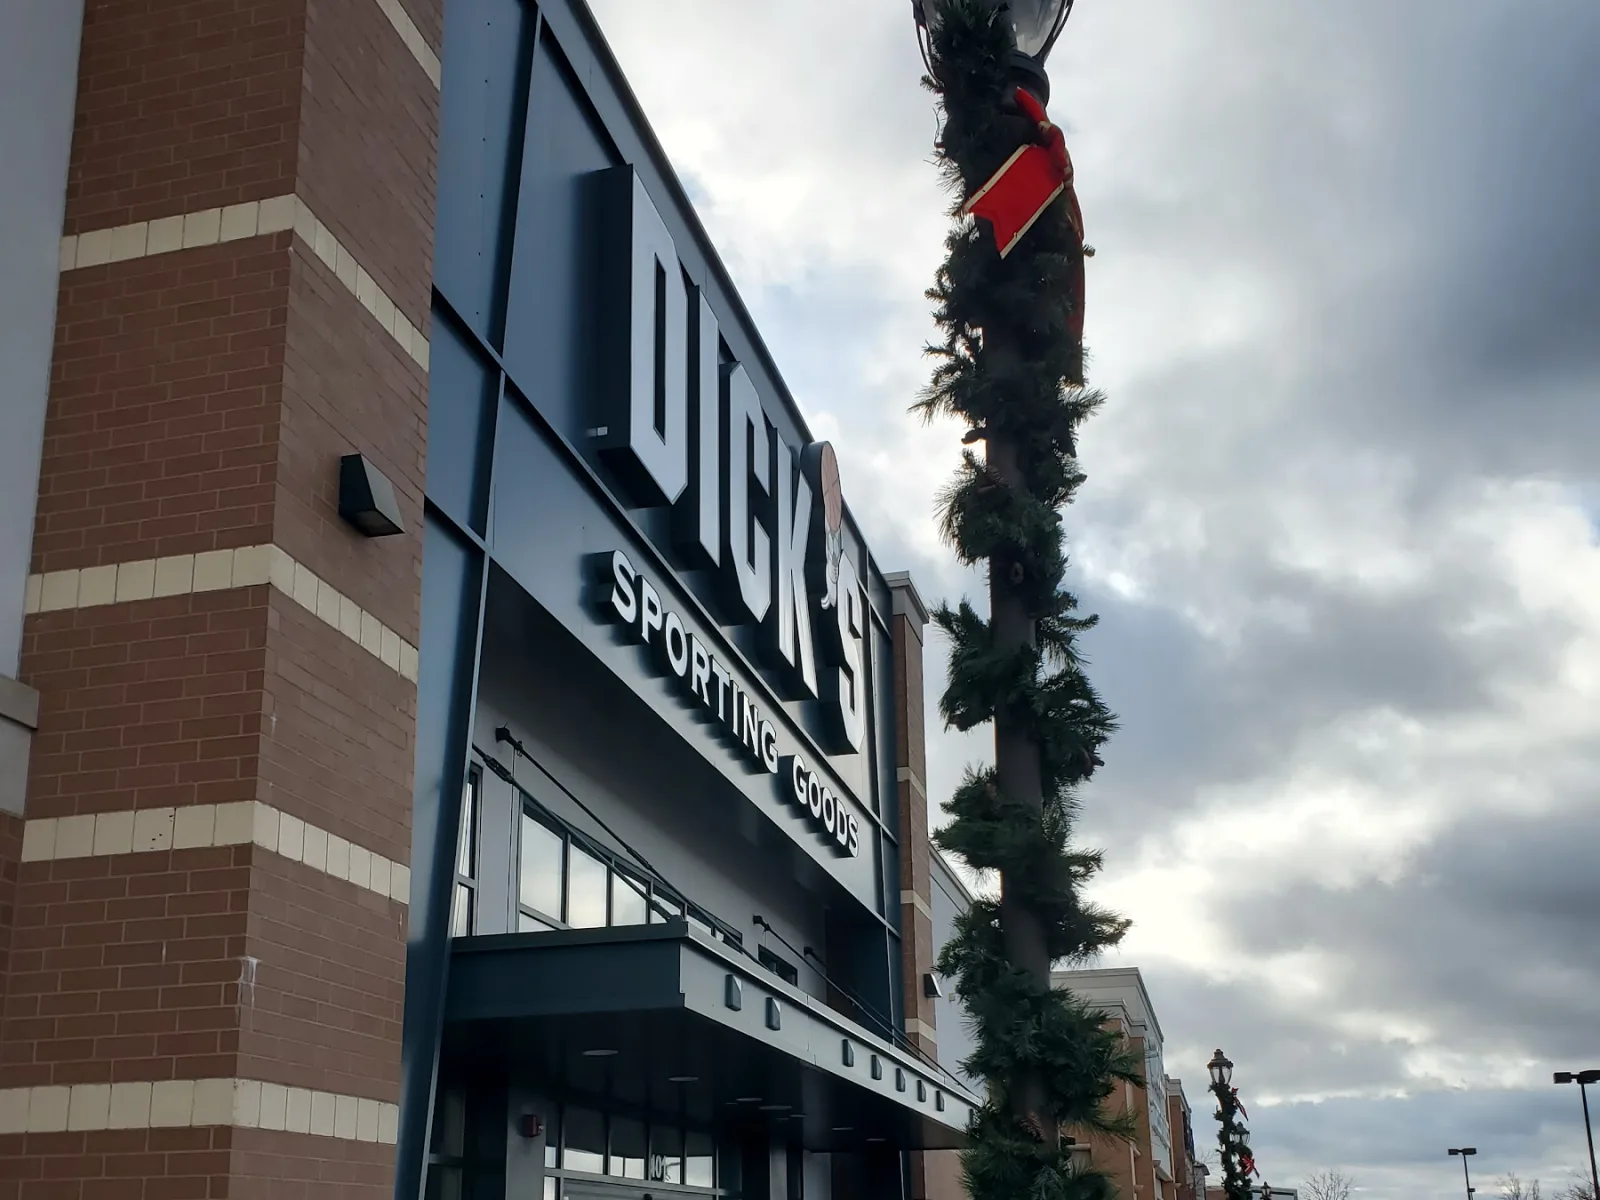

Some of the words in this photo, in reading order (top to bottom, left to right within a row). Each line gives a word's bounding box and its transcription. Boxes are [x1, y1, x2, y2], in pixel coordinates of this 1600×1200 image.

[628, 165, 867, 755] DICK'S
[611, 549, 778, 774] SPORTING
[792, 754, 860, 858] GOODS
